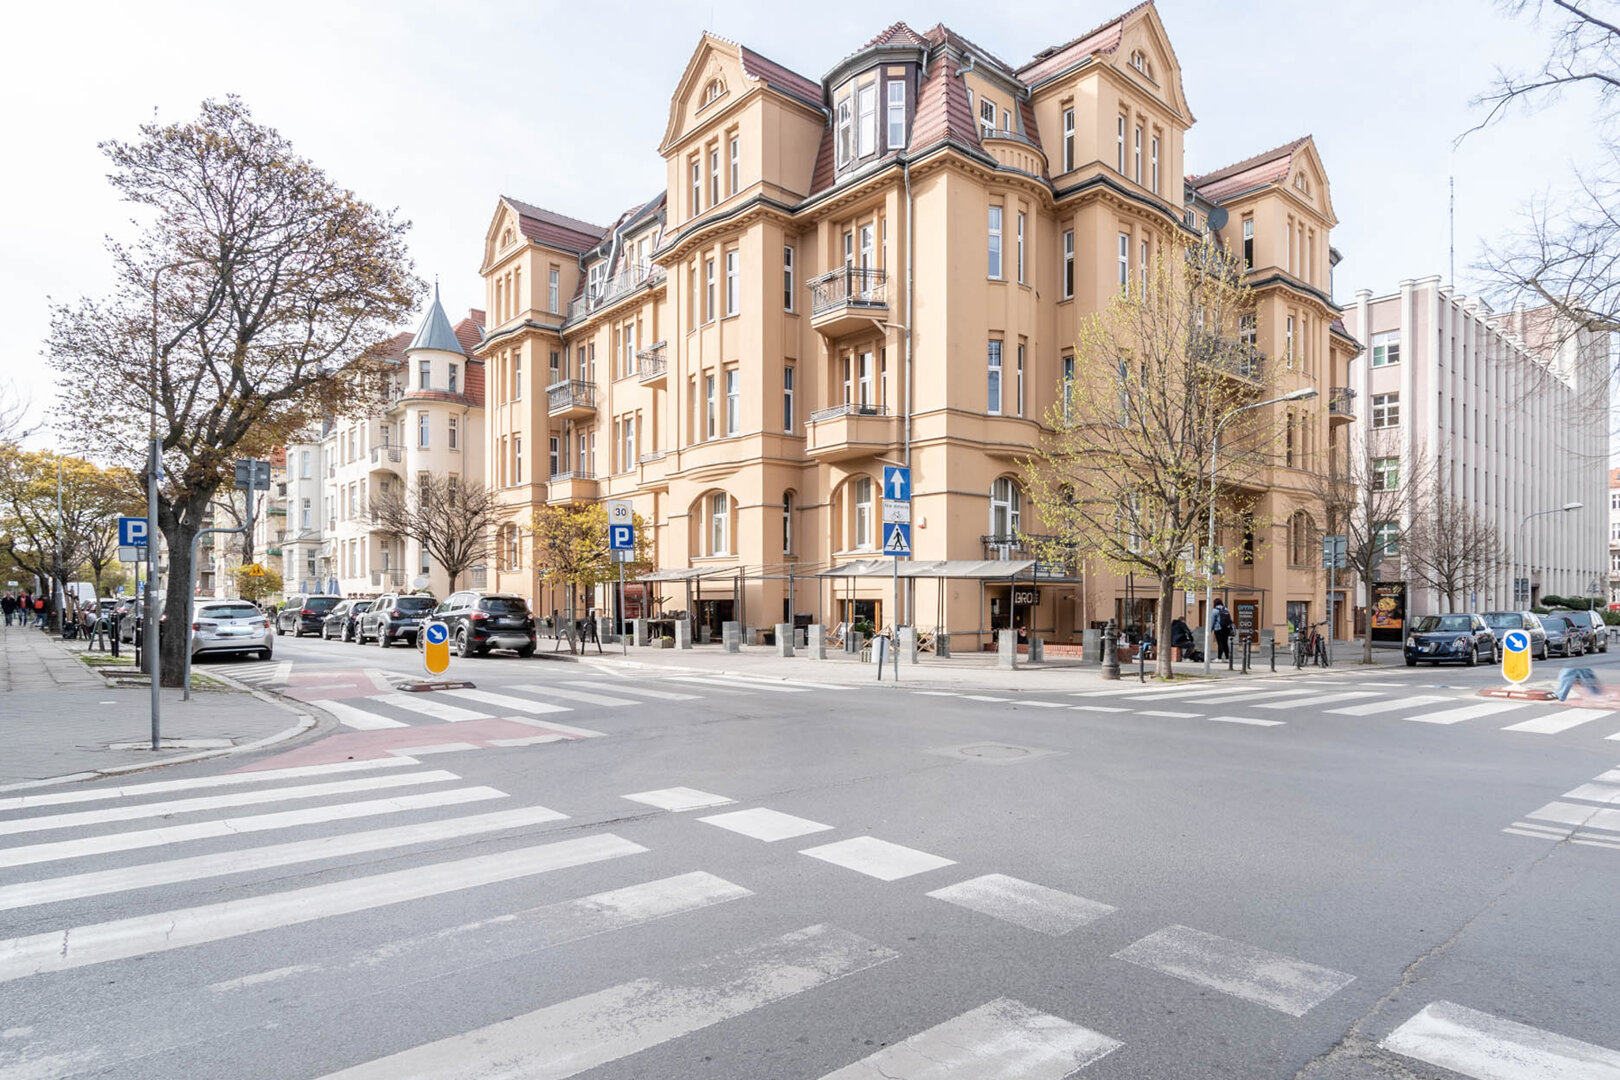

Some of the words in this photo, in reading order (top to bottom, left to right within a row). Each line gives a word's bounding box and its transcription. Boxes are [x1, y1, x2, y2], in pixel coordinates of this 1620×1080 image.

[615, 507, 627, 517] 30
[127, 520, 148, 544] P
[615, 527, 630, 548] P
